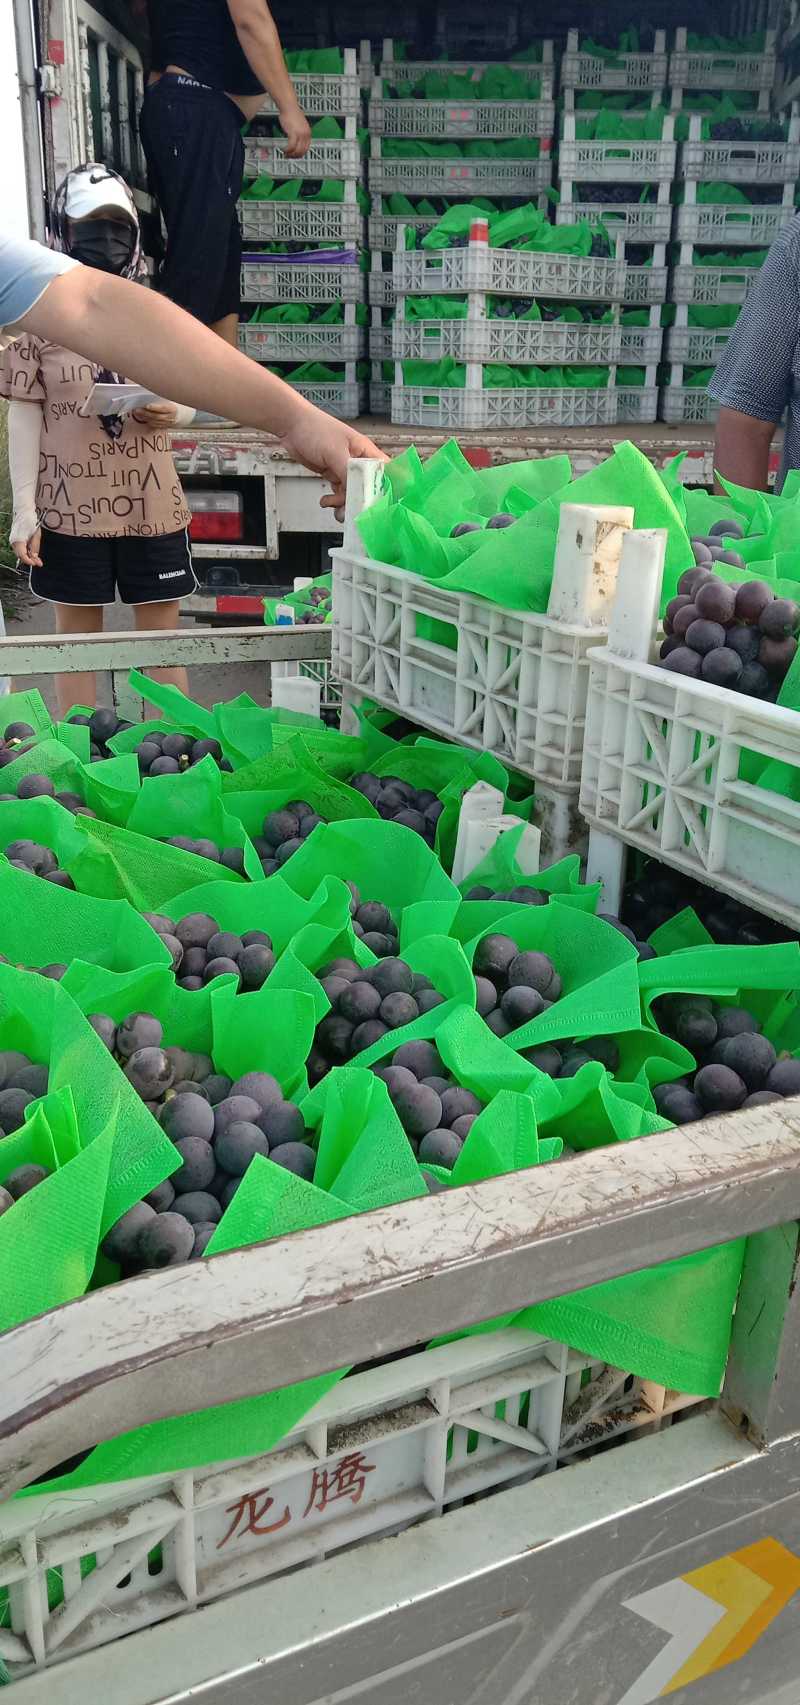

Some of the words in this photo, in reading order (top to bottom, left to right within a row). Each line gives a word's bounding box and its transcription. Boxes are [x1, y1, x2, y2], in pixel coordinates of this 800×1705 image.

[60, 364, 94, 384] UIT
[110, 462, 161, 491] VUIT
[78, 495, 146, 525] LOUIS
[216, 1451, 377, 1550] 龙腾
